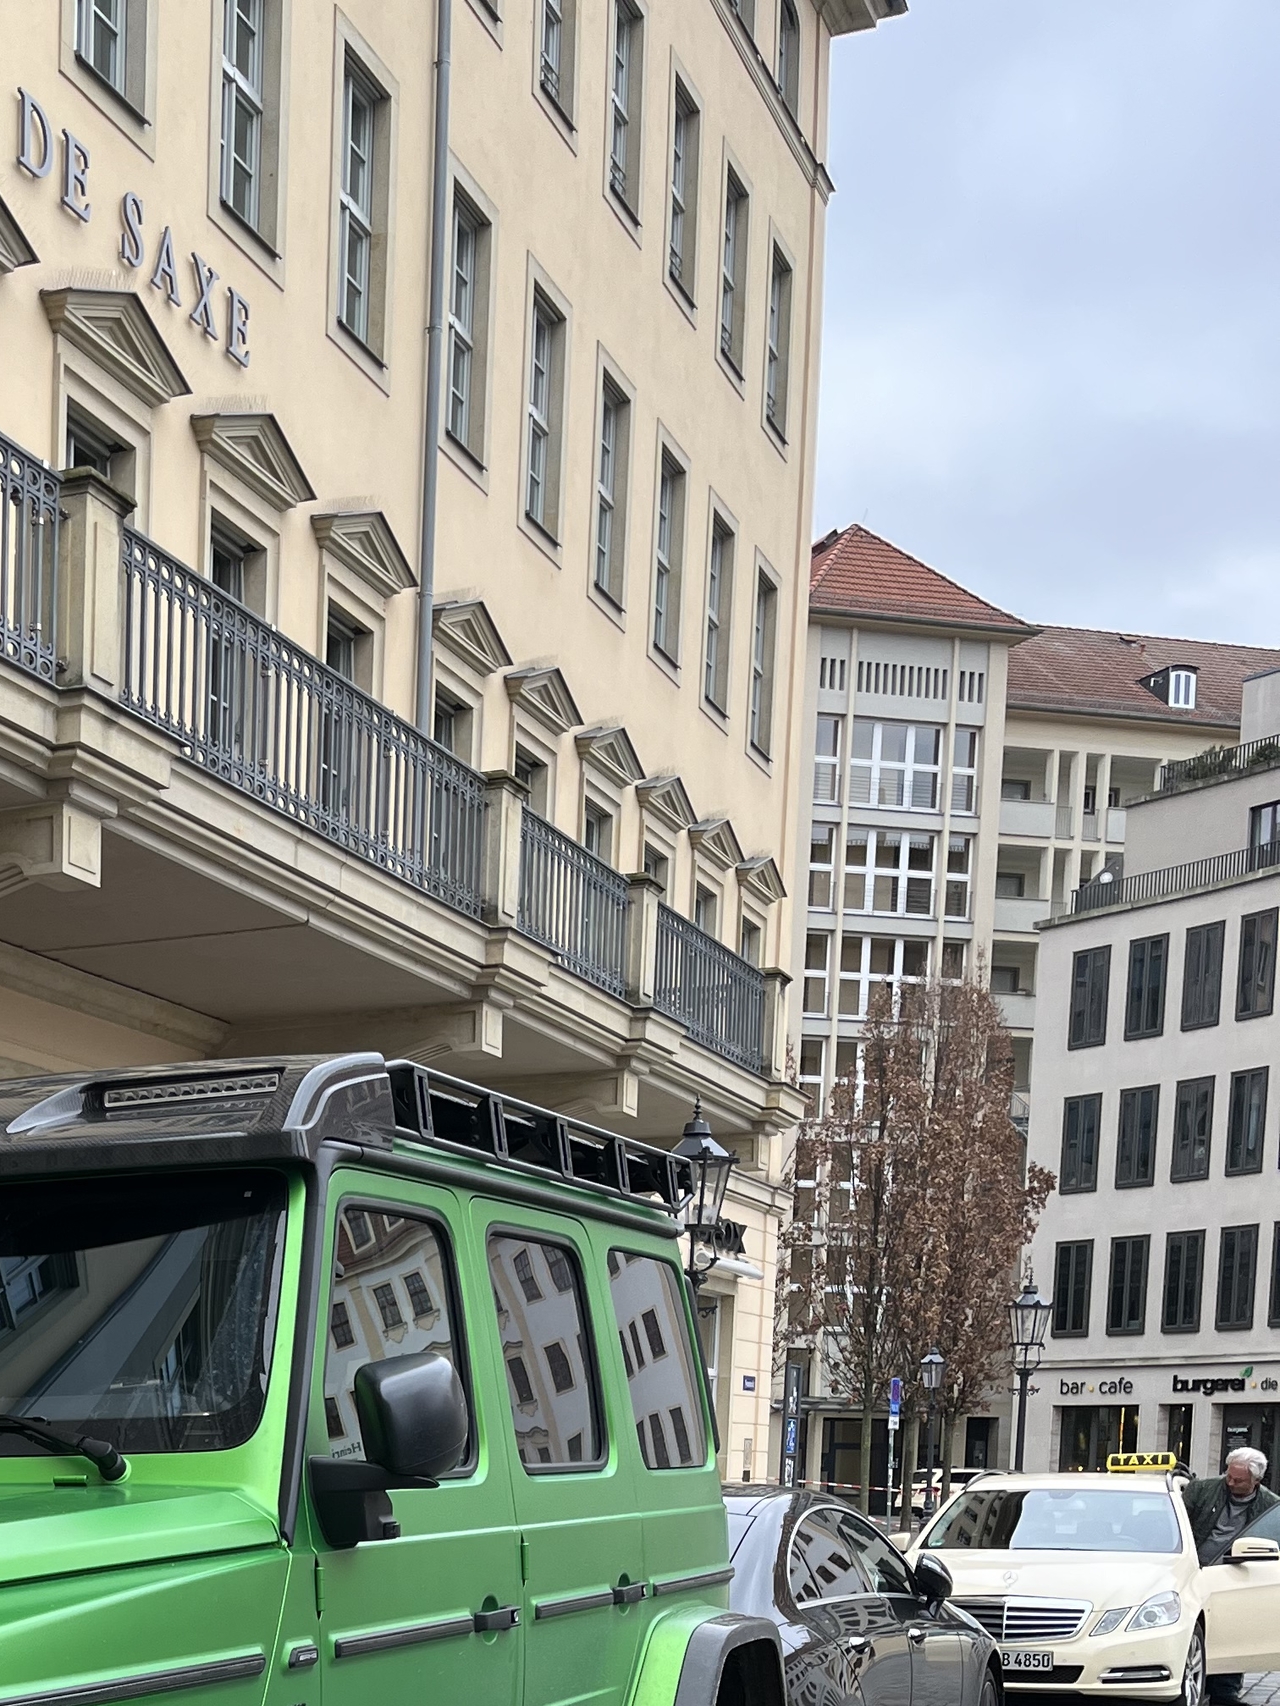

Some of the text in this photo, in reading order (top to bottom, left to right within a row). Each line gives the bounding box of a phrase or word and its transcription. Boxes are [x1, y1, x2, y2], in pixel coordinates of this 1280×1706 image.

[17, 87, 91, 223] DE
[121, 191, 251, 367] SAXE
[1060, 1377, 1133, 1395] bar cafe
[1172, 1374, 1278, 1396] burgerei die
[1118, 1454, 1162, 1466] TAXI
[1002, 1653, 1050, 1668] B 4850
